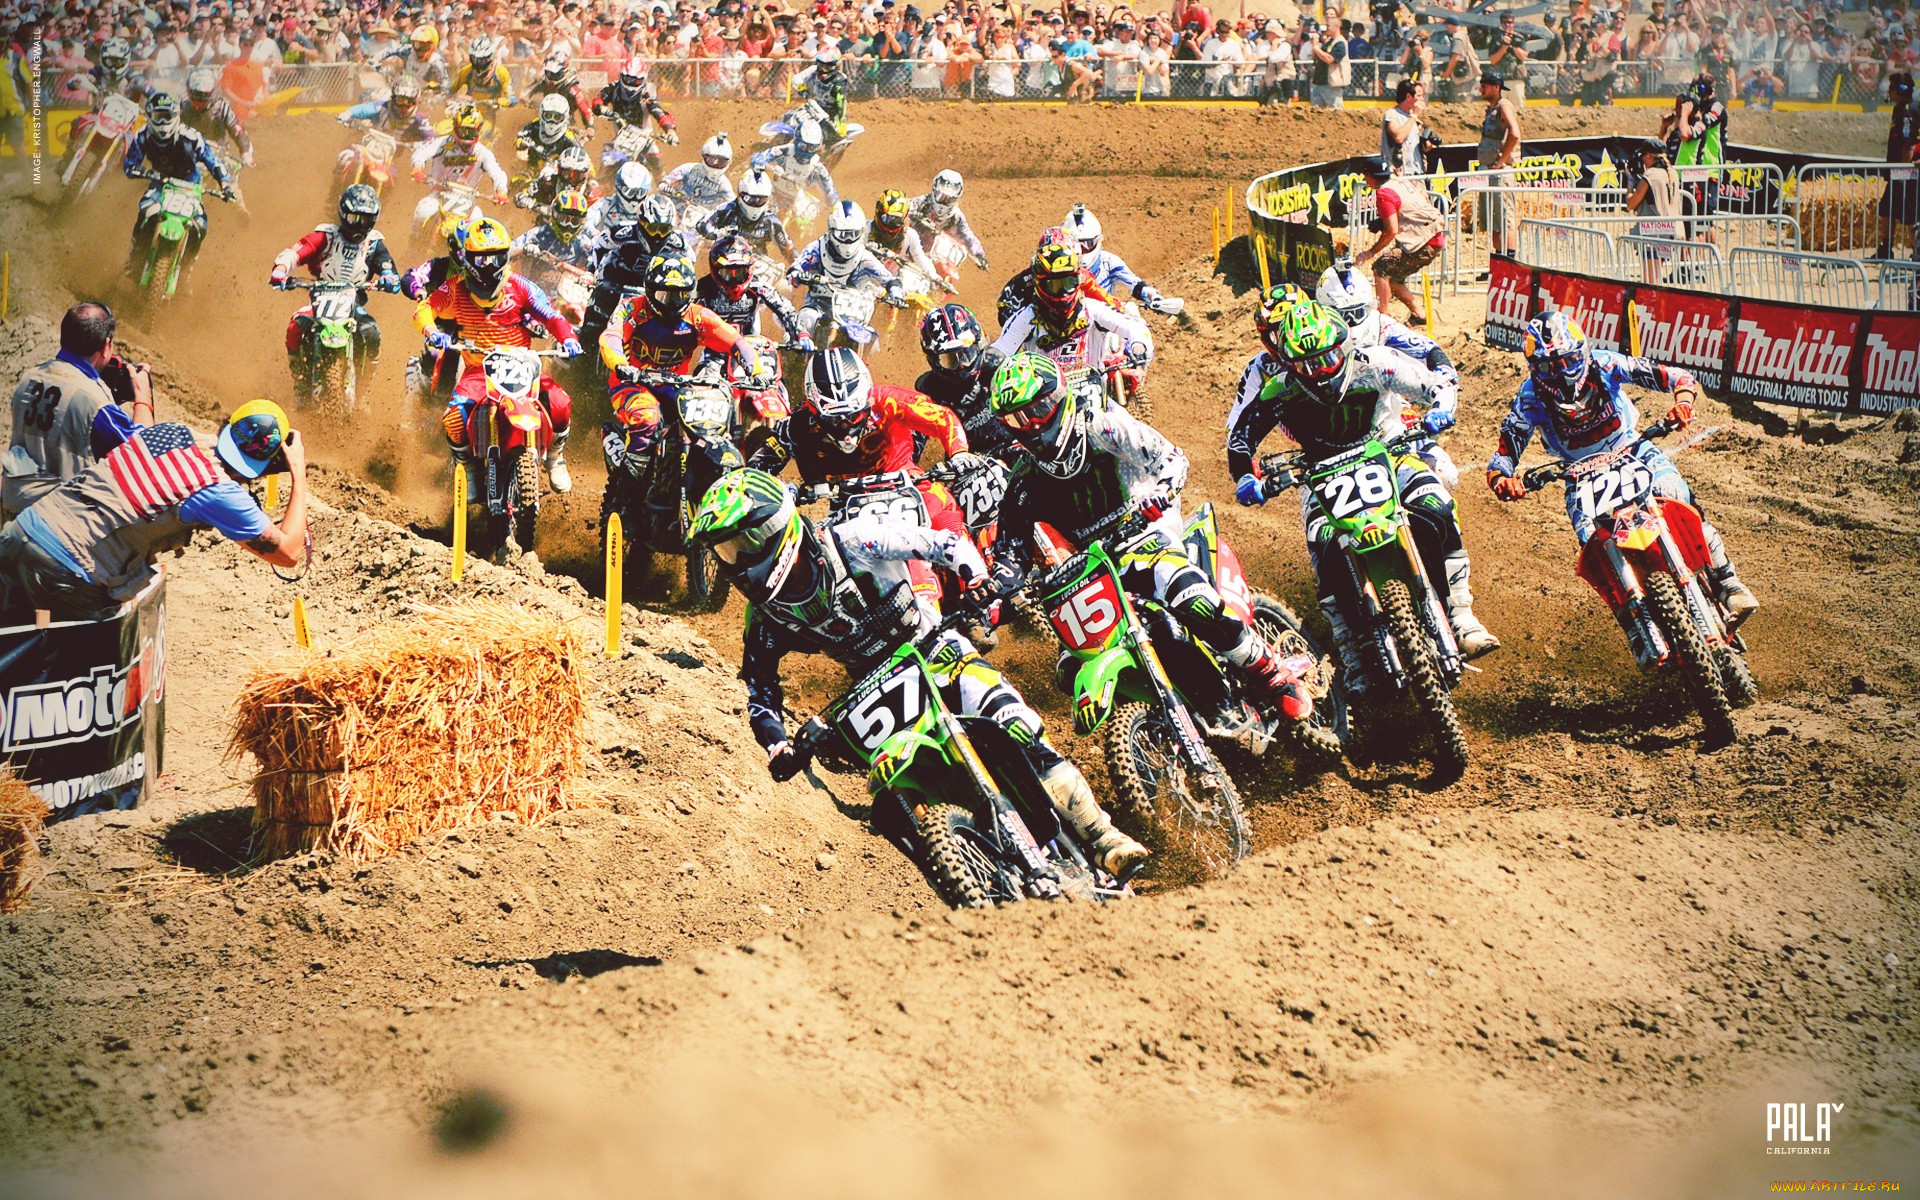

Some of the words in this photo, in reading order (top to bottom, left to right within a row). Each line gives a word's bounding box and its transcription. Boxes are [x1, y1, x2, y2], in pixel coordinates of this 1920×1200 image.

[1554, 192, 1584, 200] NATIONAL
[1736, 318, 1852, 388] Makita
[24, 380, 62, 432] 33
[1730, 375, 1783, 399] INDUSTRIAL
[1784, 382, 1816, 404] POWER
[1817, 389, 1849, 408] TOOLS
[1324, 464, 1393, 520] 28
[1059, 580, 1116, 647] 15
[1061, 583, 1081, 600] LUCAS
[848, 665, 921, 749] 57
[857, 681, 880, 703] LUCAS
[880, 670, 894, 684] OIL
[1168, 708, 1201, 766] DUNLOP
[998, 813, 1041, 870] DUNLOP
